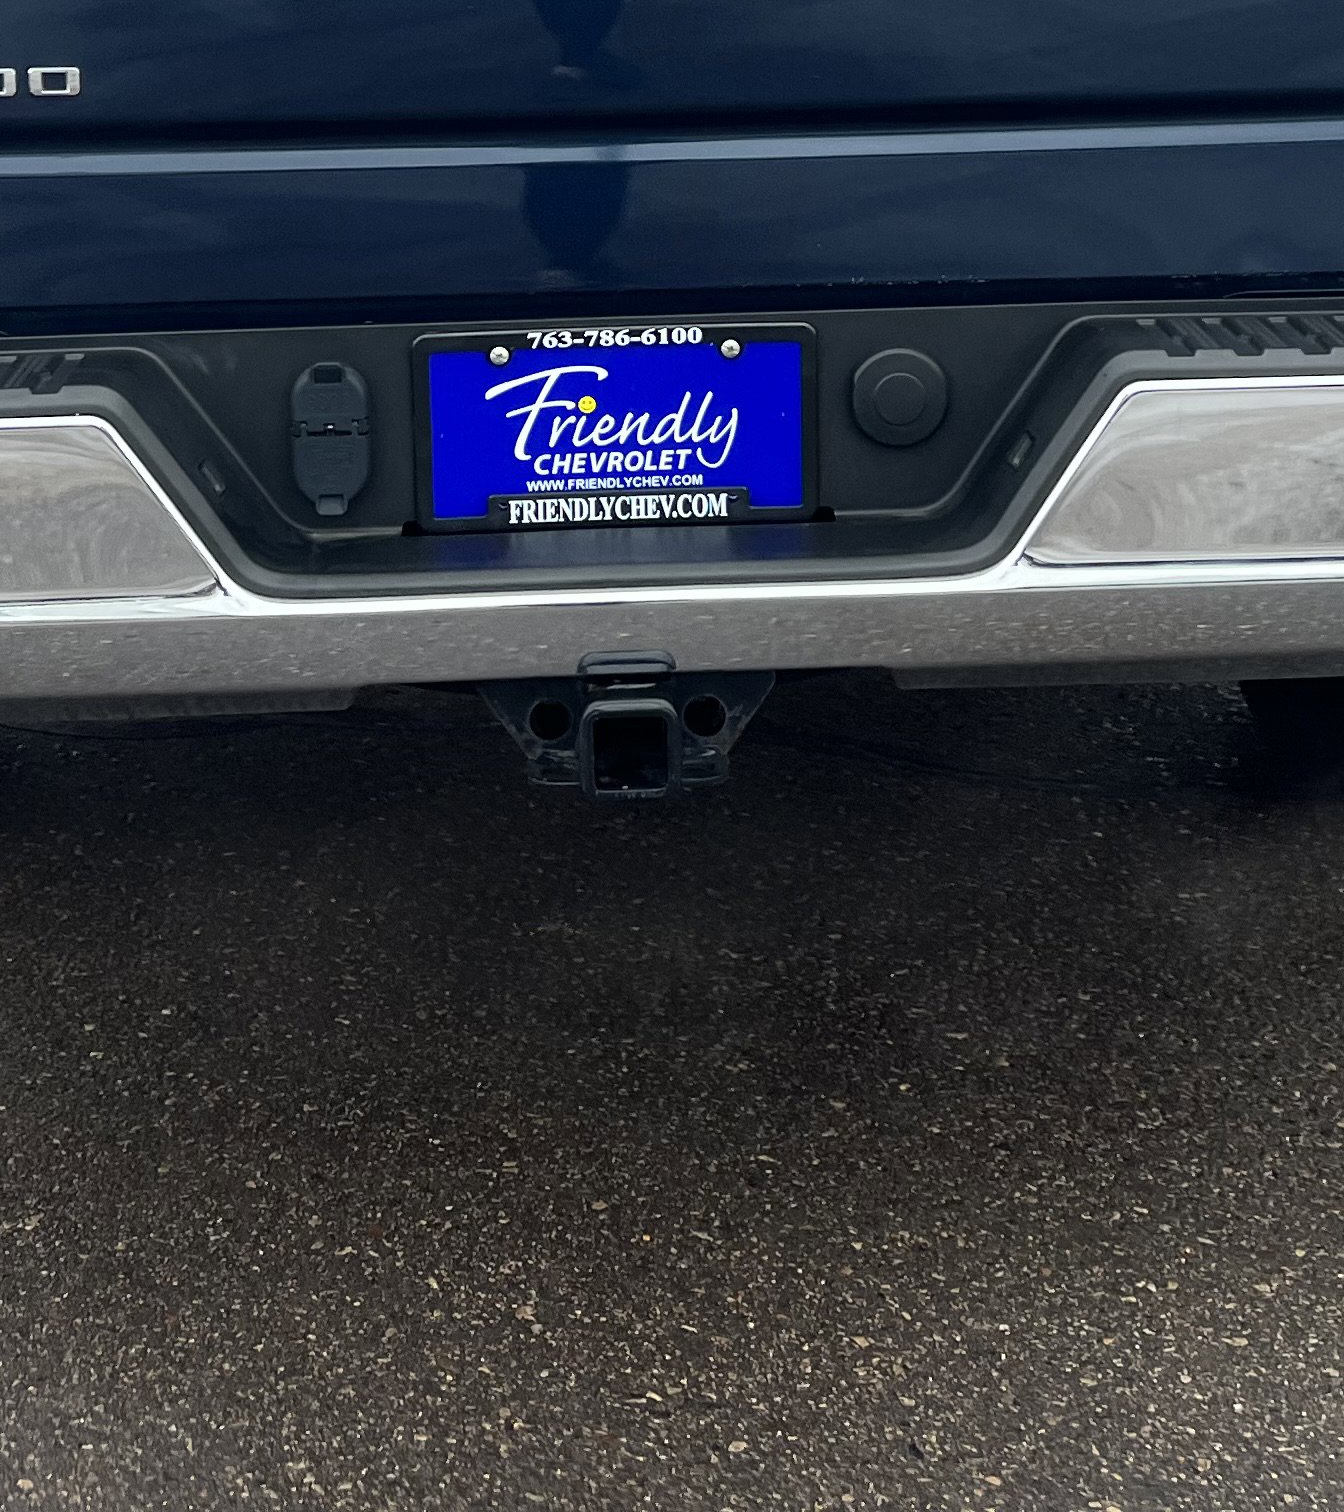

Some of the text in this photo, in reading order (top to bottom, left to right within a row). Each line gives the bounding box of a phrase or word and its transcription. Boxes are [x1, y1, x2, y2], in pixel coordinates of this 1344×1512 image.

[527, 327, 703, 349] 763-786-6100
[485, 365, 739, 469] Friendly
[533, 449, 692, 476] CHEVROLET
[526, 474, 704, 493] WWW.FRIENDLYCHEV.COM
[508, 492, 729, 524] FRIENDLYCHEV.COM
